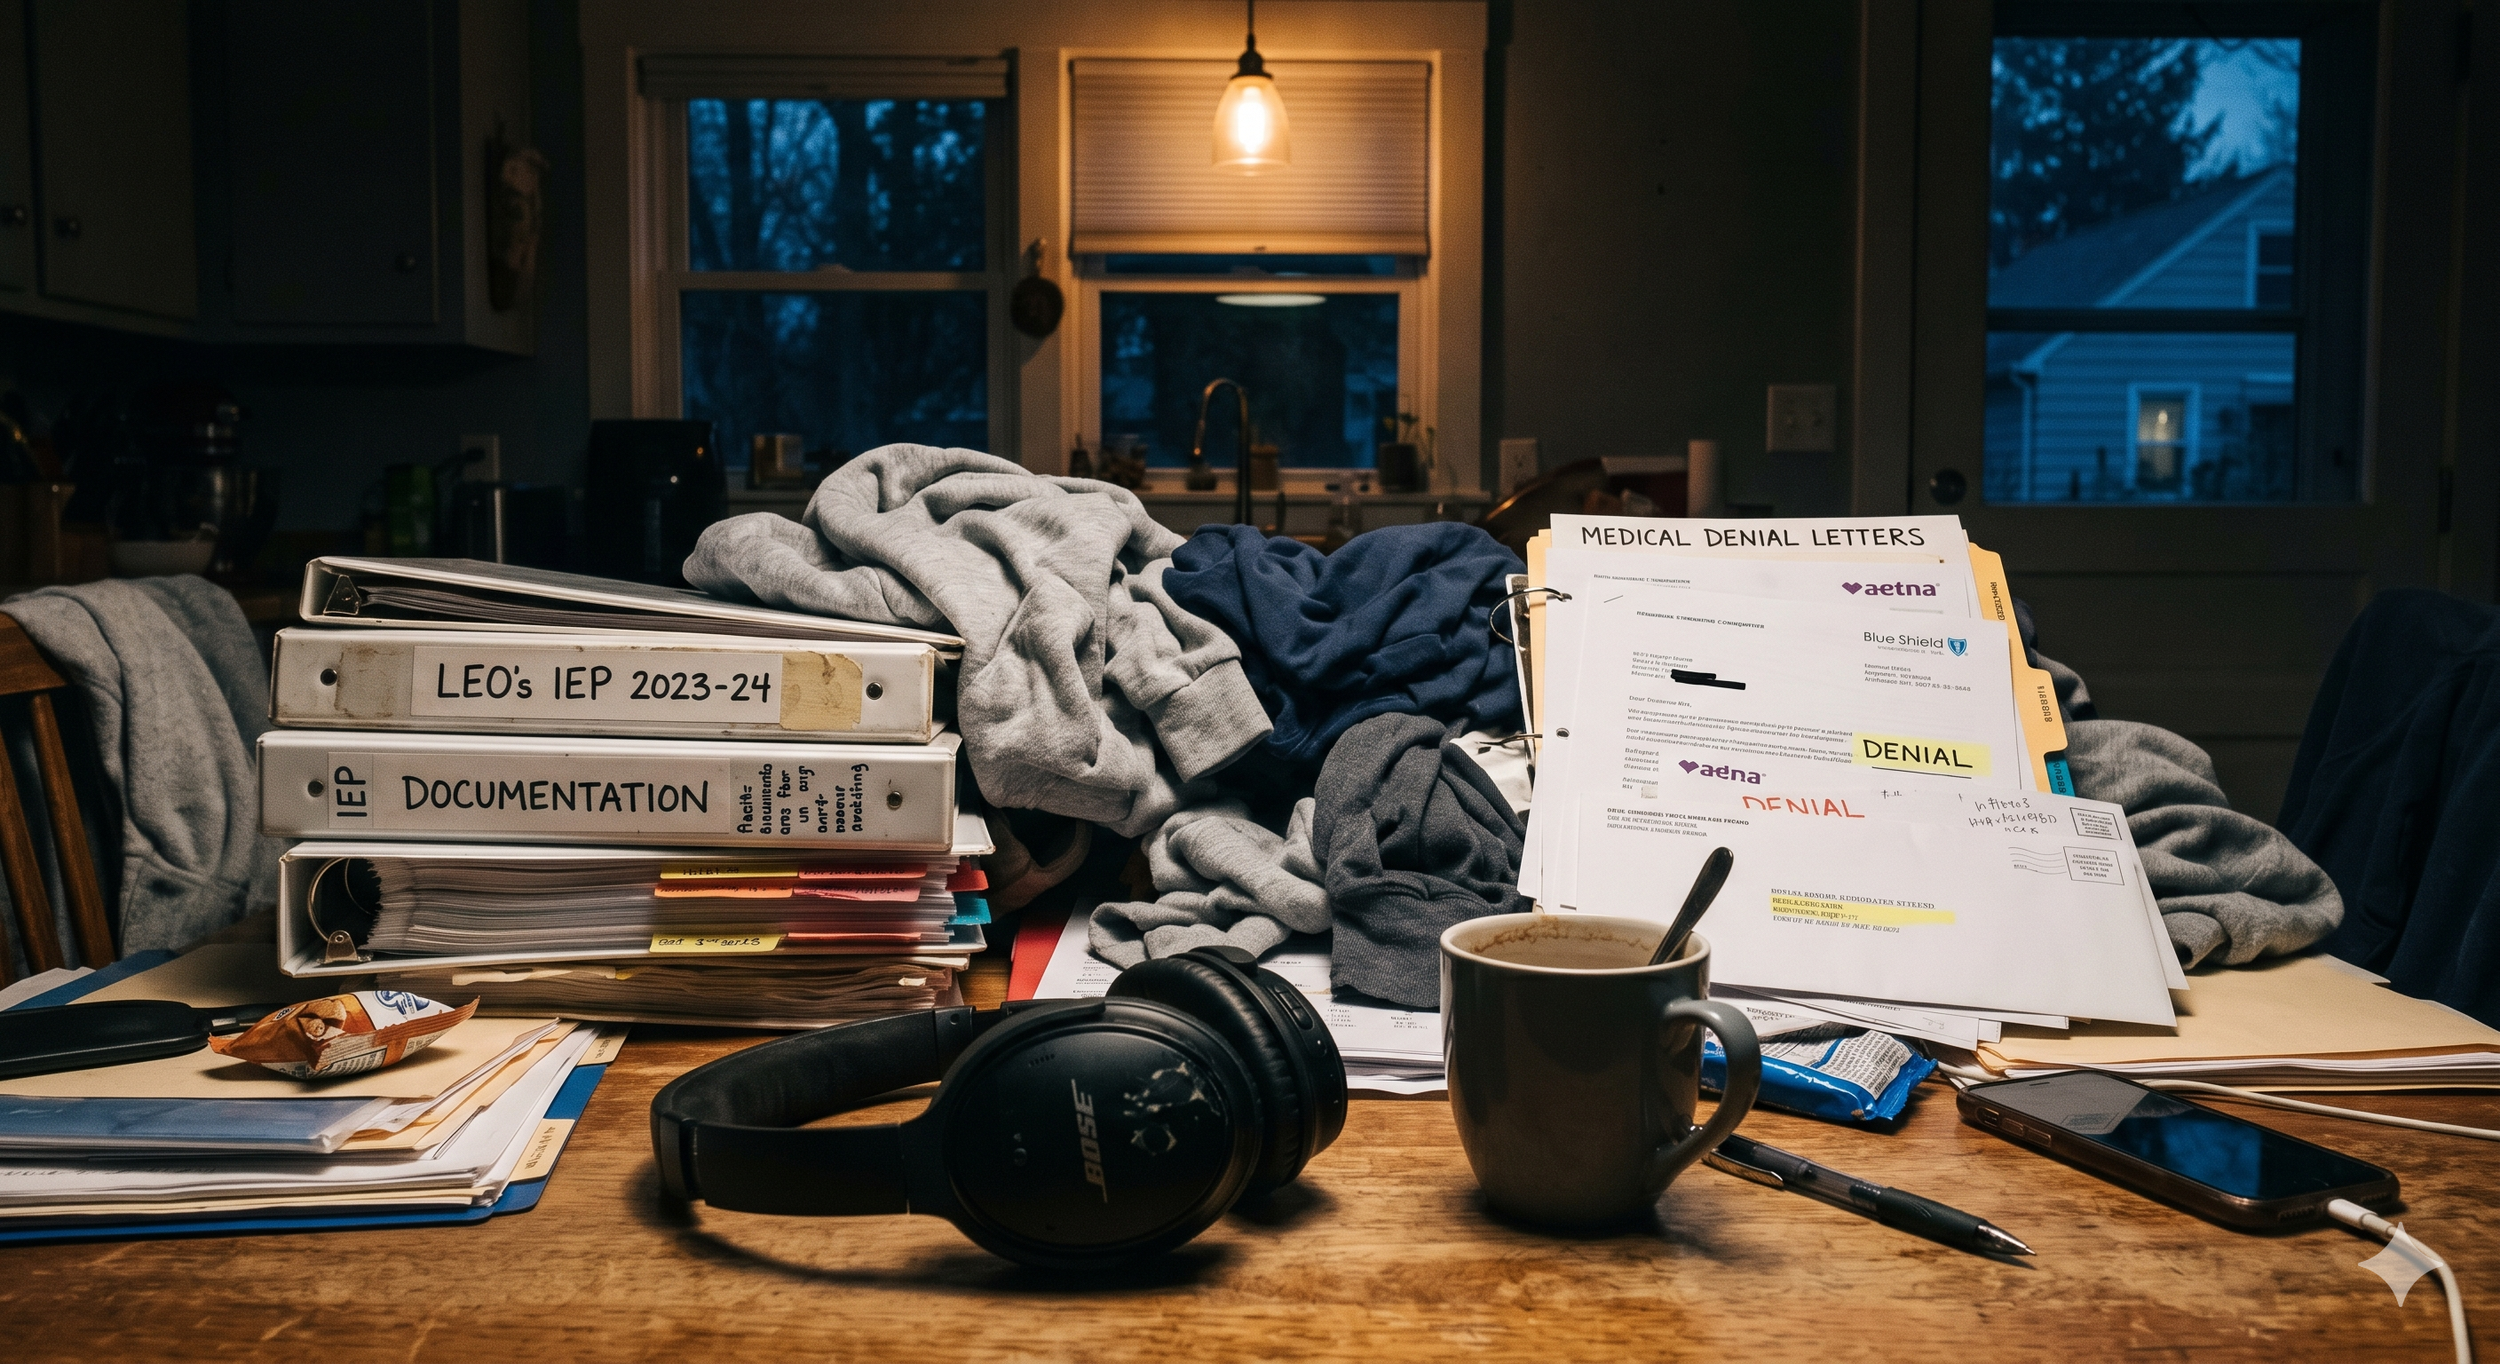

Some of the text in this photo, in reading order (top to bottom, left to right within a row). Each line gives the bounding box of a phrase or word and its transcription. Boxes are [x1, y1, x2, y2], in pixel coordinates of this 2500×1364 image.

[1581, 527, 1925, 547] MEDICAL DENIAL LETTERS
[1864, 581, 1937, 597] aetna
[1863, 631, 1944, 649] Blue Shield
[437, 662, 771, 703] LEO's IEP 2023-24
[1862, 739, 1973, 769] DENIAL
[334, 765, 368, 818] IEP
[401, 775, 709, 814] DOCUMENTATION
[1071, 1078, 1108, 1204] BOSE
